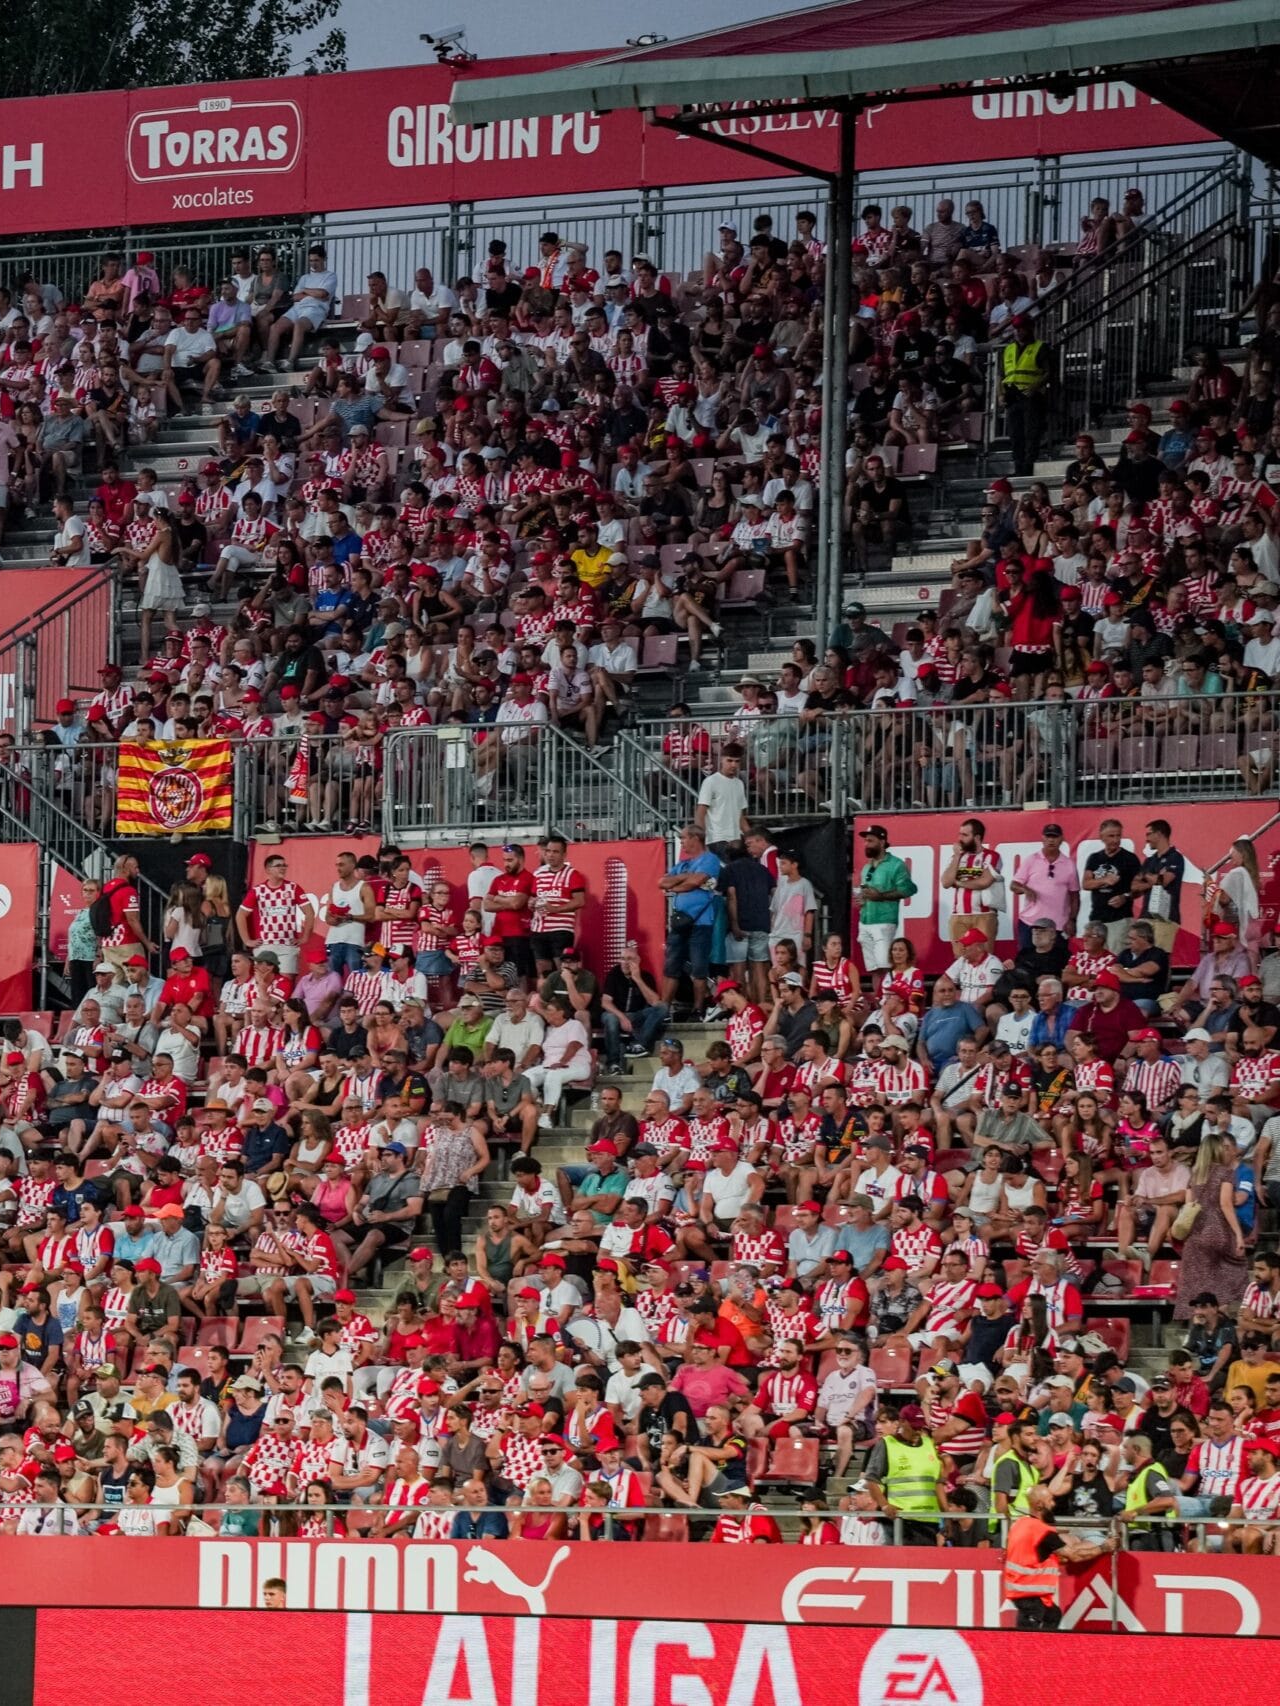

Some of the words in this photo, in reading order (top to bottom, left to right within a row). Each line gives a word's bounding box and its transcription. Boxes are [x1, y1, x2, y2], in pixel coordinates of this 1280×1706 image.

[203, 101, 227, 111] 1890
[171, 186, 254, 210] xocolates
[884, 1653, 959, 1703] EA
